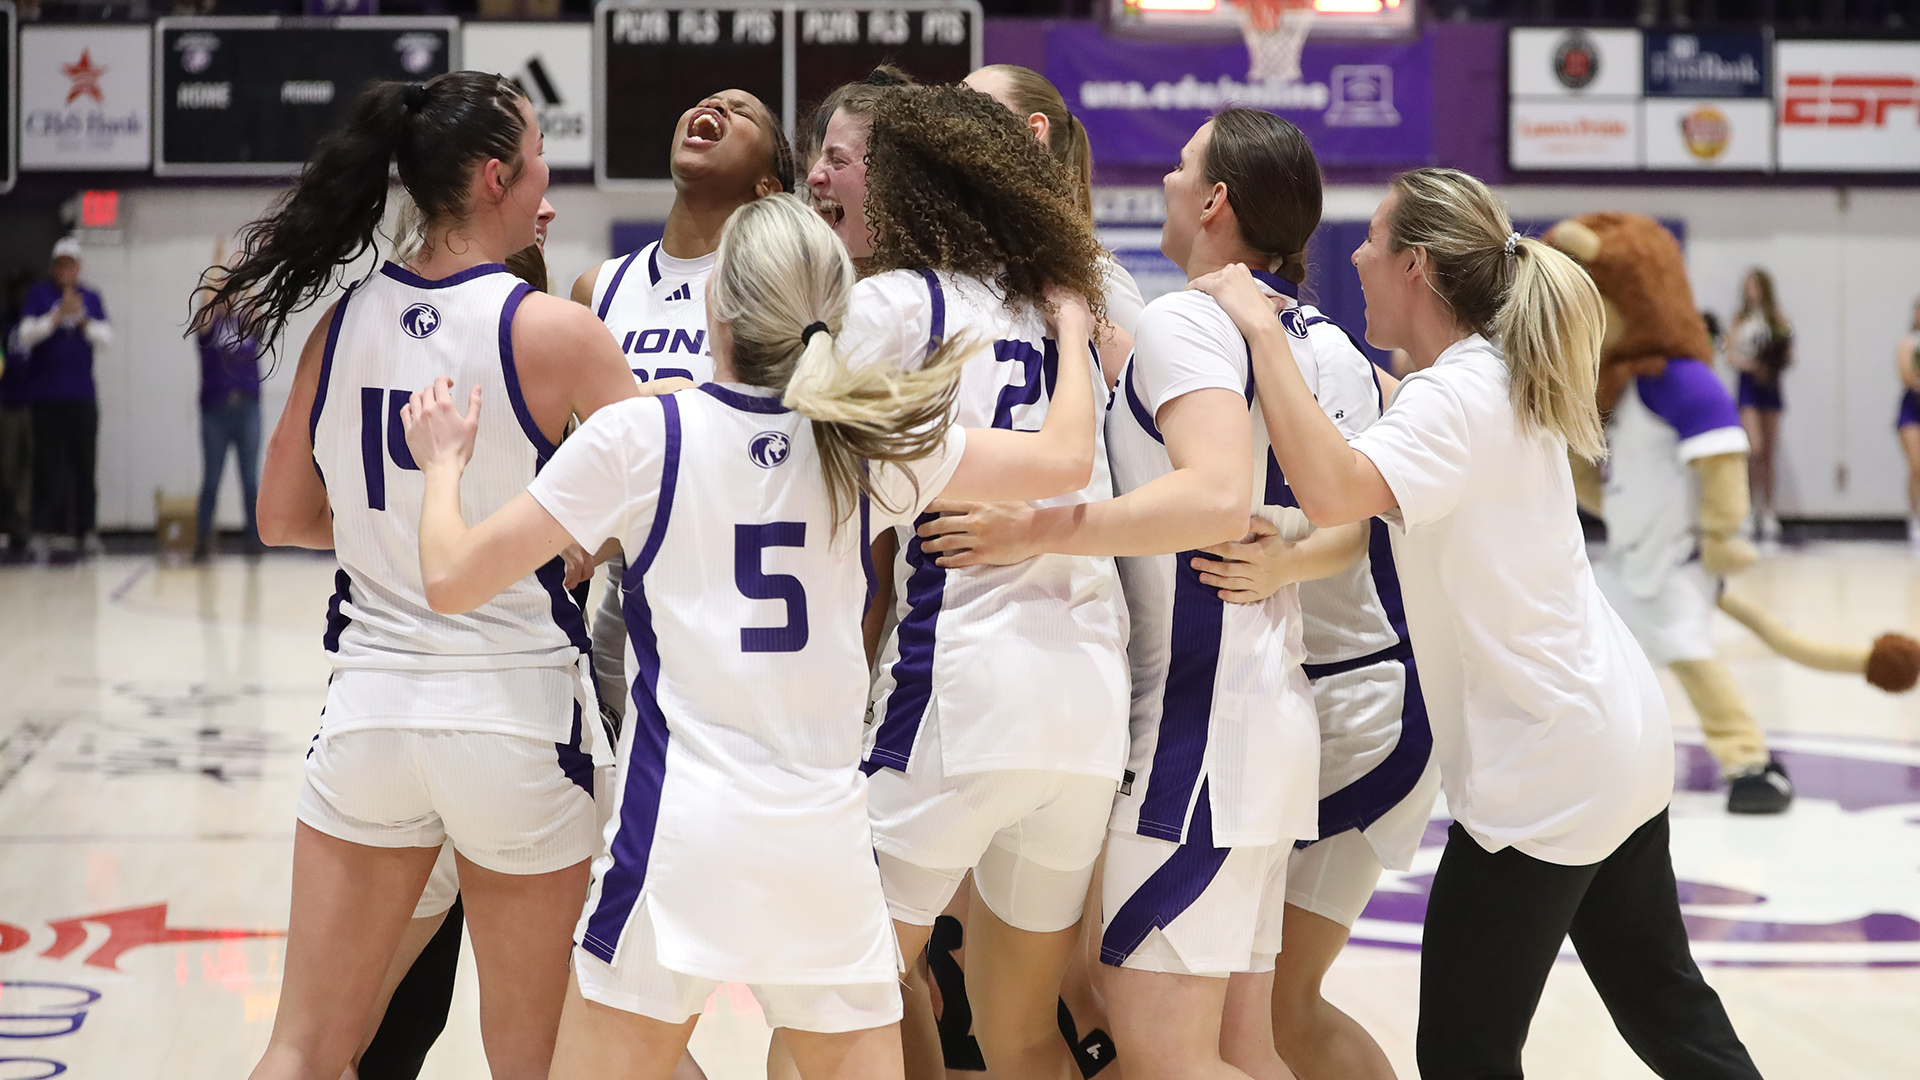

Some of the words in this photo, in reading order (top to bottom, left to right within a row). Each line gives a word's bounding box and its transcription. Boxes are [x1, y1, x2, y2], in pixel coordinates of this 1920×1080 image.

[1783, 75, 1920, 125] ESP
[622, 328, 711, 356] ION
[734, 521, 809, 652] 5
